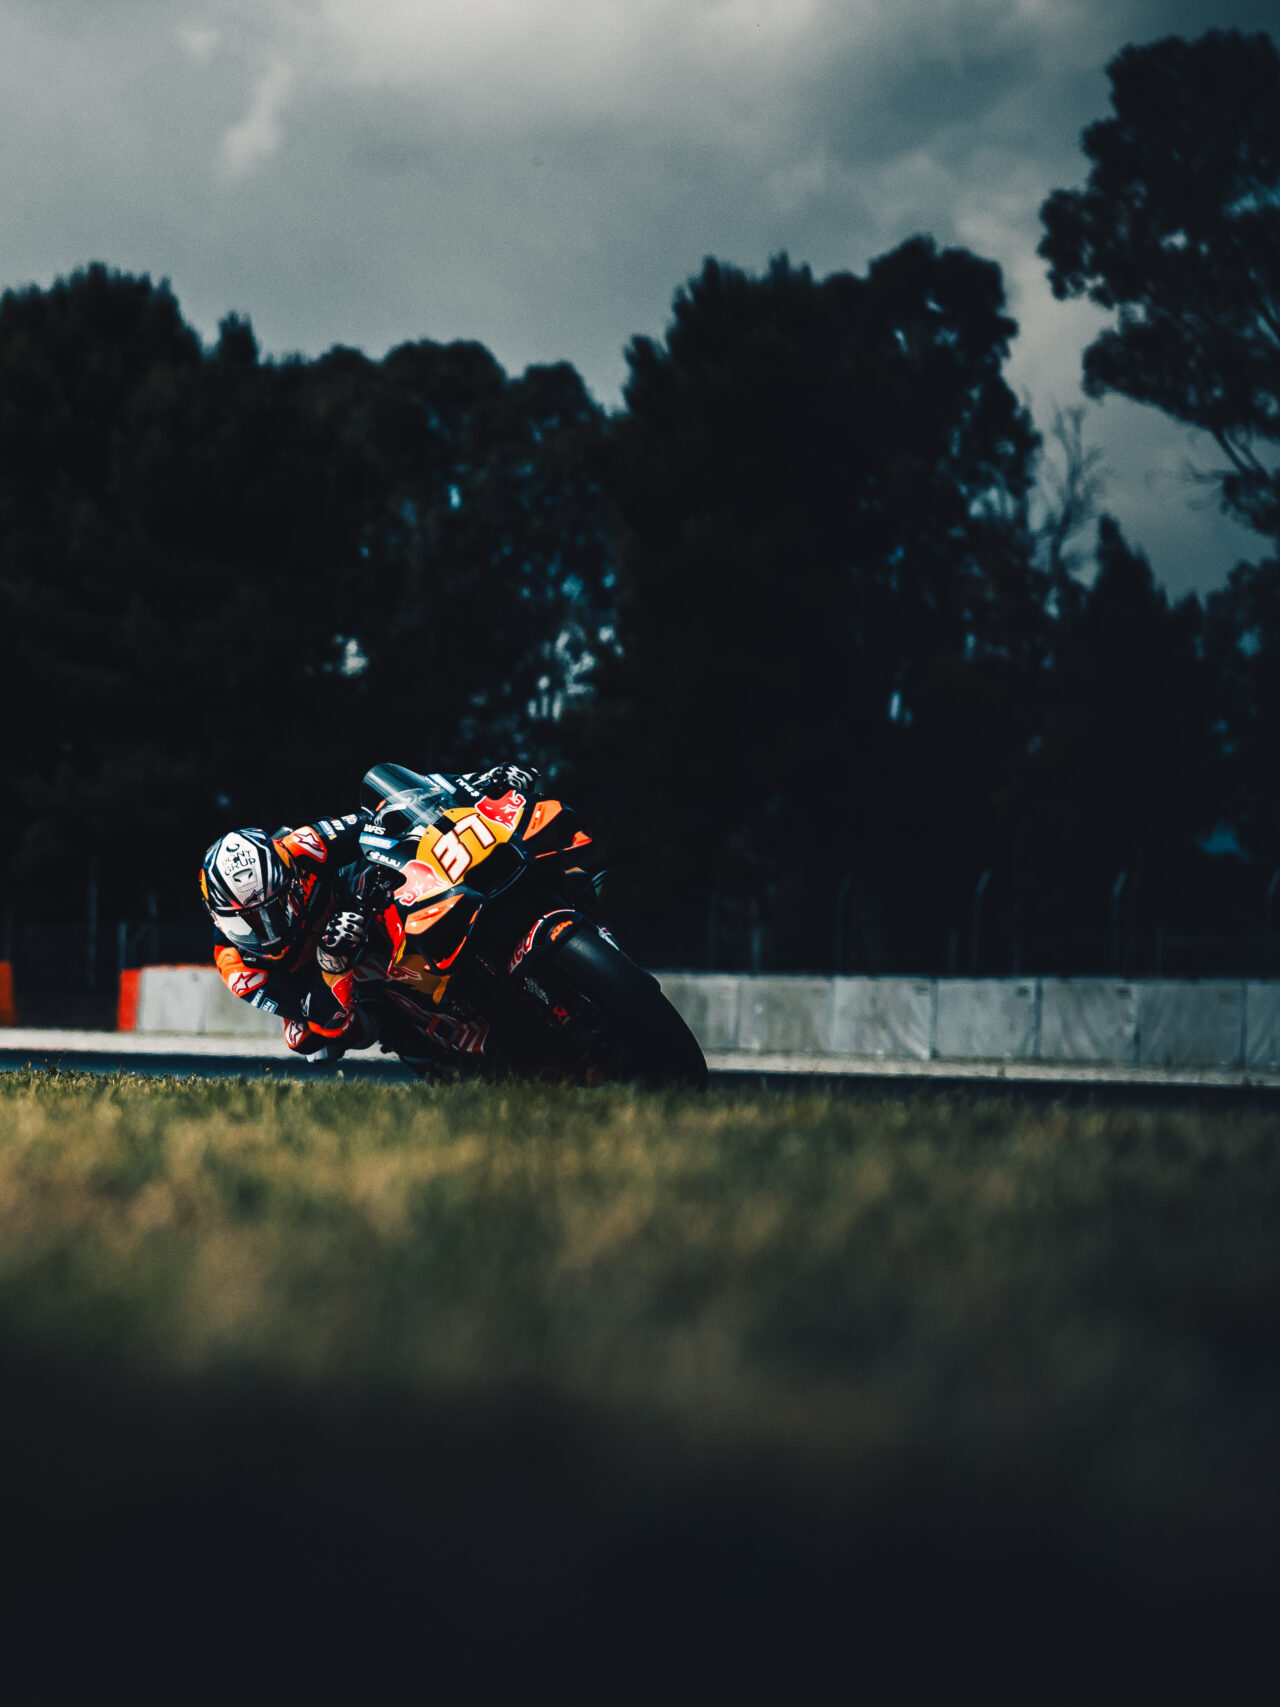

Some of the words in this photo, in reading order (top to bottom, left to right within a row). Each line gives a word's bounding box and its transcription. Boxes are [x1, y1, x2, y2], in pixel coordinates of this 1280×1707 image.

[363, 823, 387, 836] WRS
[431, 813, 497, 884] 37
[224, 857, 257, 877] GRUP
